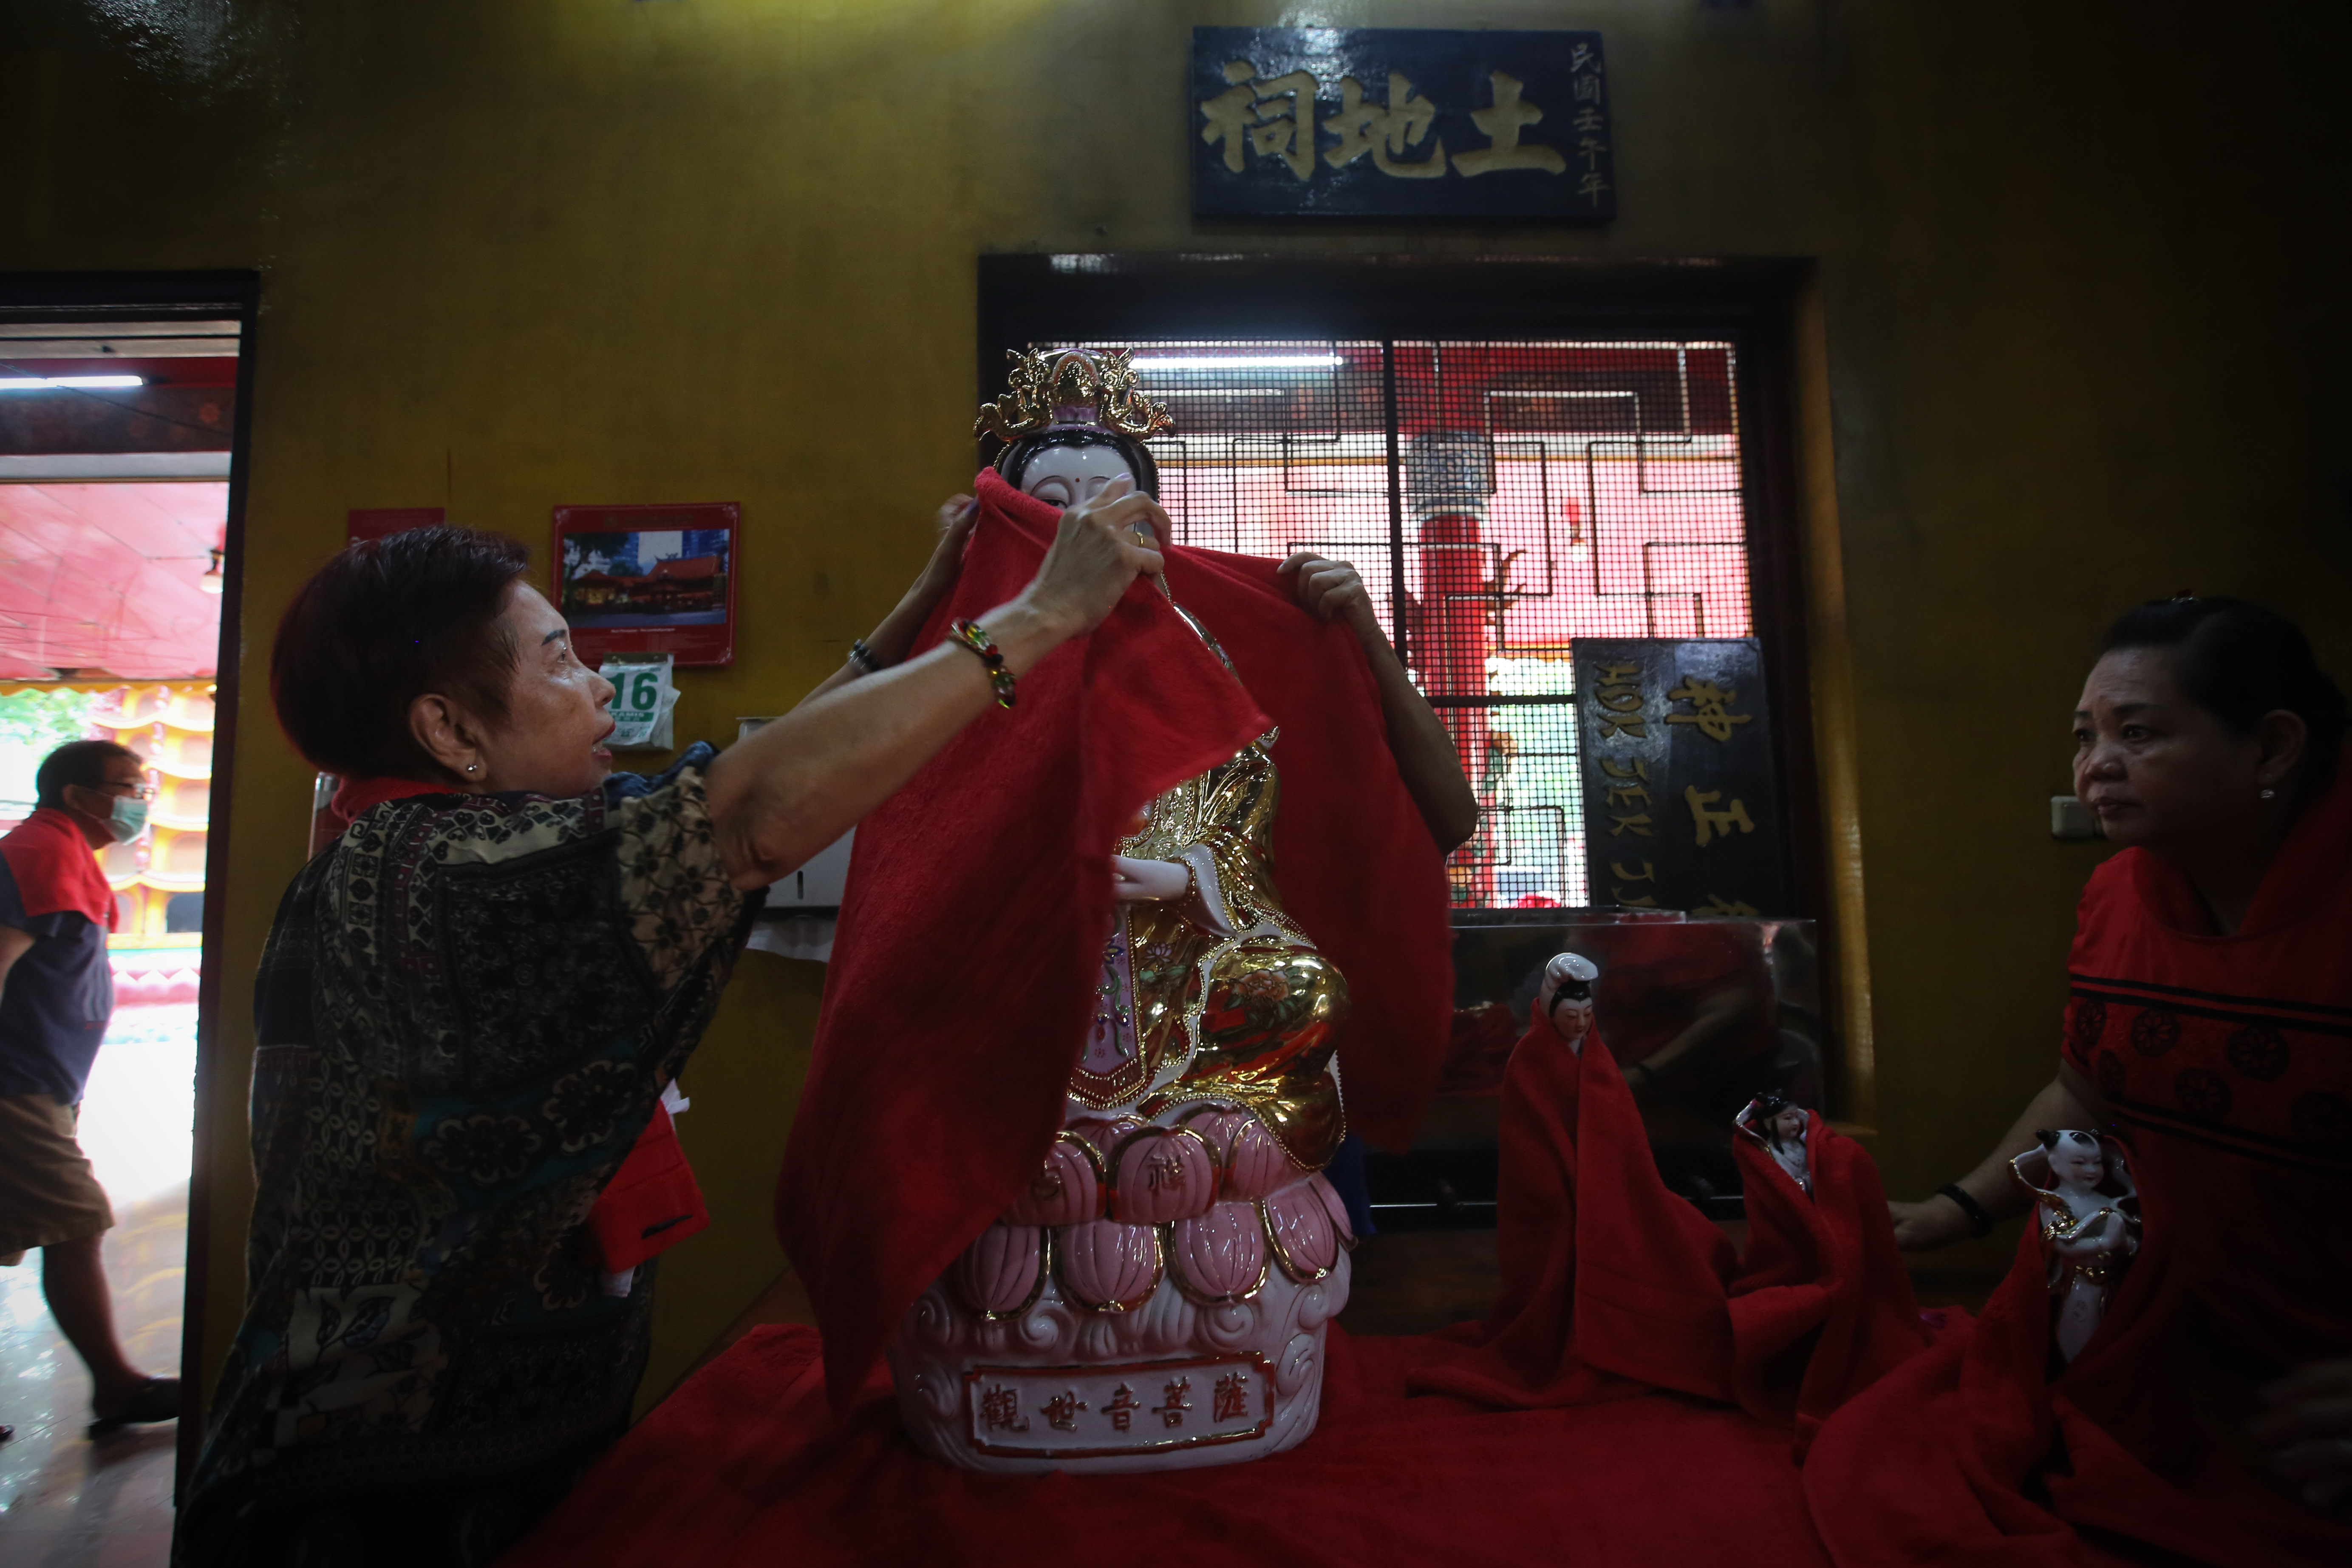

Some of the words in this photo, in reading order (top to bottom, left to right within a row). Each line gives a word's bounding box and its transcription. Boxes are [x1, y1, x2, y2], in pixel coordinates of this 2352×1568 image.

[1200, 59, 1567, 181] 土地祠
[606, 673, 658, 710] 16
[1593, 662, 1647, 739] HOK
[979, 1371, 1250, 1432] 觀世音菩薩
